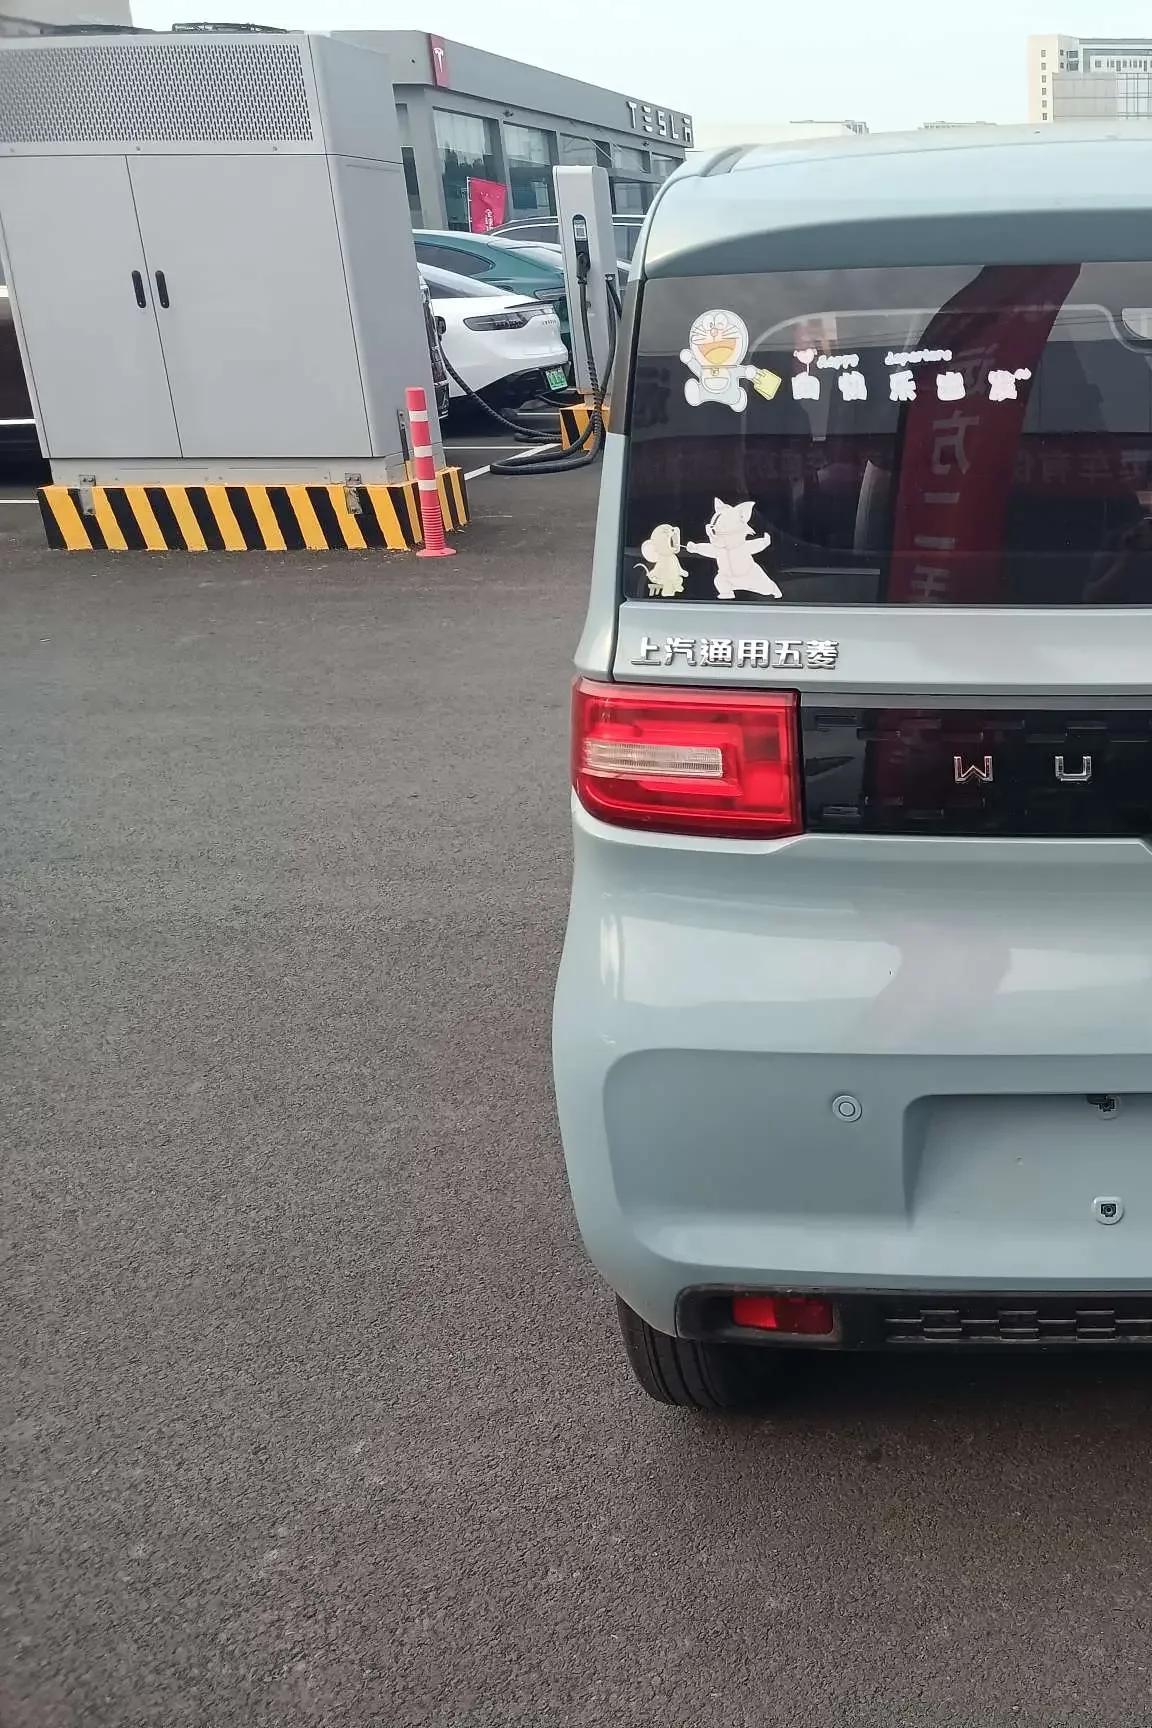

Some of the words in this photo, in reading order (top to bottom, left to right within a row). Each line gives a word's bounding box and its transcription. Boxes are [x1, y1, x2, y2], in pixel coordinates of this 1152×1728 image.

[627, 101, 692, 143] TESLA
[630, 636, 839, 670] 上汽通用五菱
